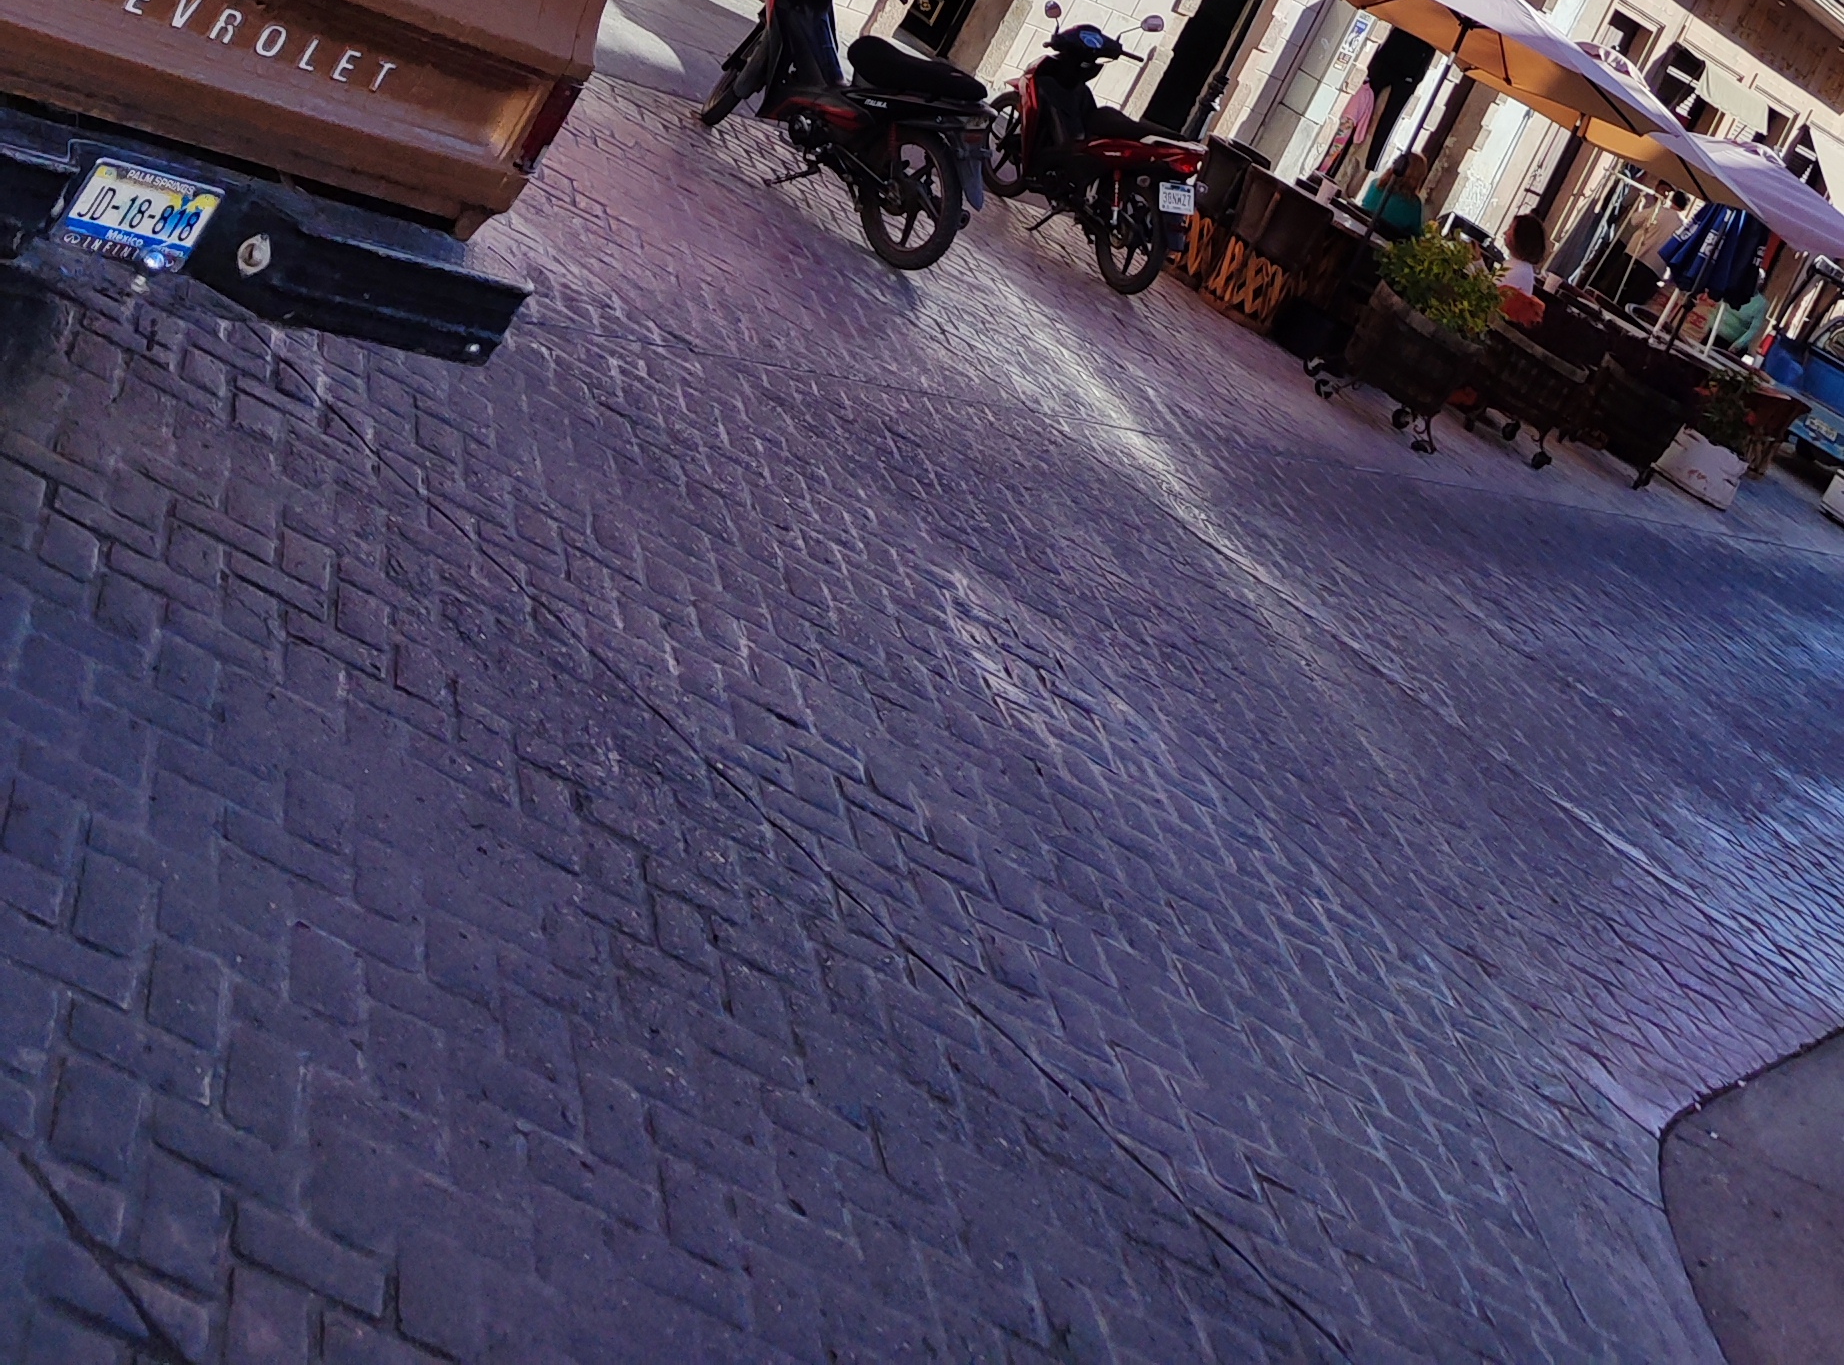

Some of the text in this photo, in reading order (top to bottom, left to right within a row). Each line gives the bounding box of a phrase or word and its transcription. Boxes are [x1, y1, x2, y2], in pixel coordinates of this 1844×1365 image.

[127, 169, 195, 196] PALM SPRINGS
[77, 185, 200, 242] JD-18-818
[105, 228, 144, 248] México
